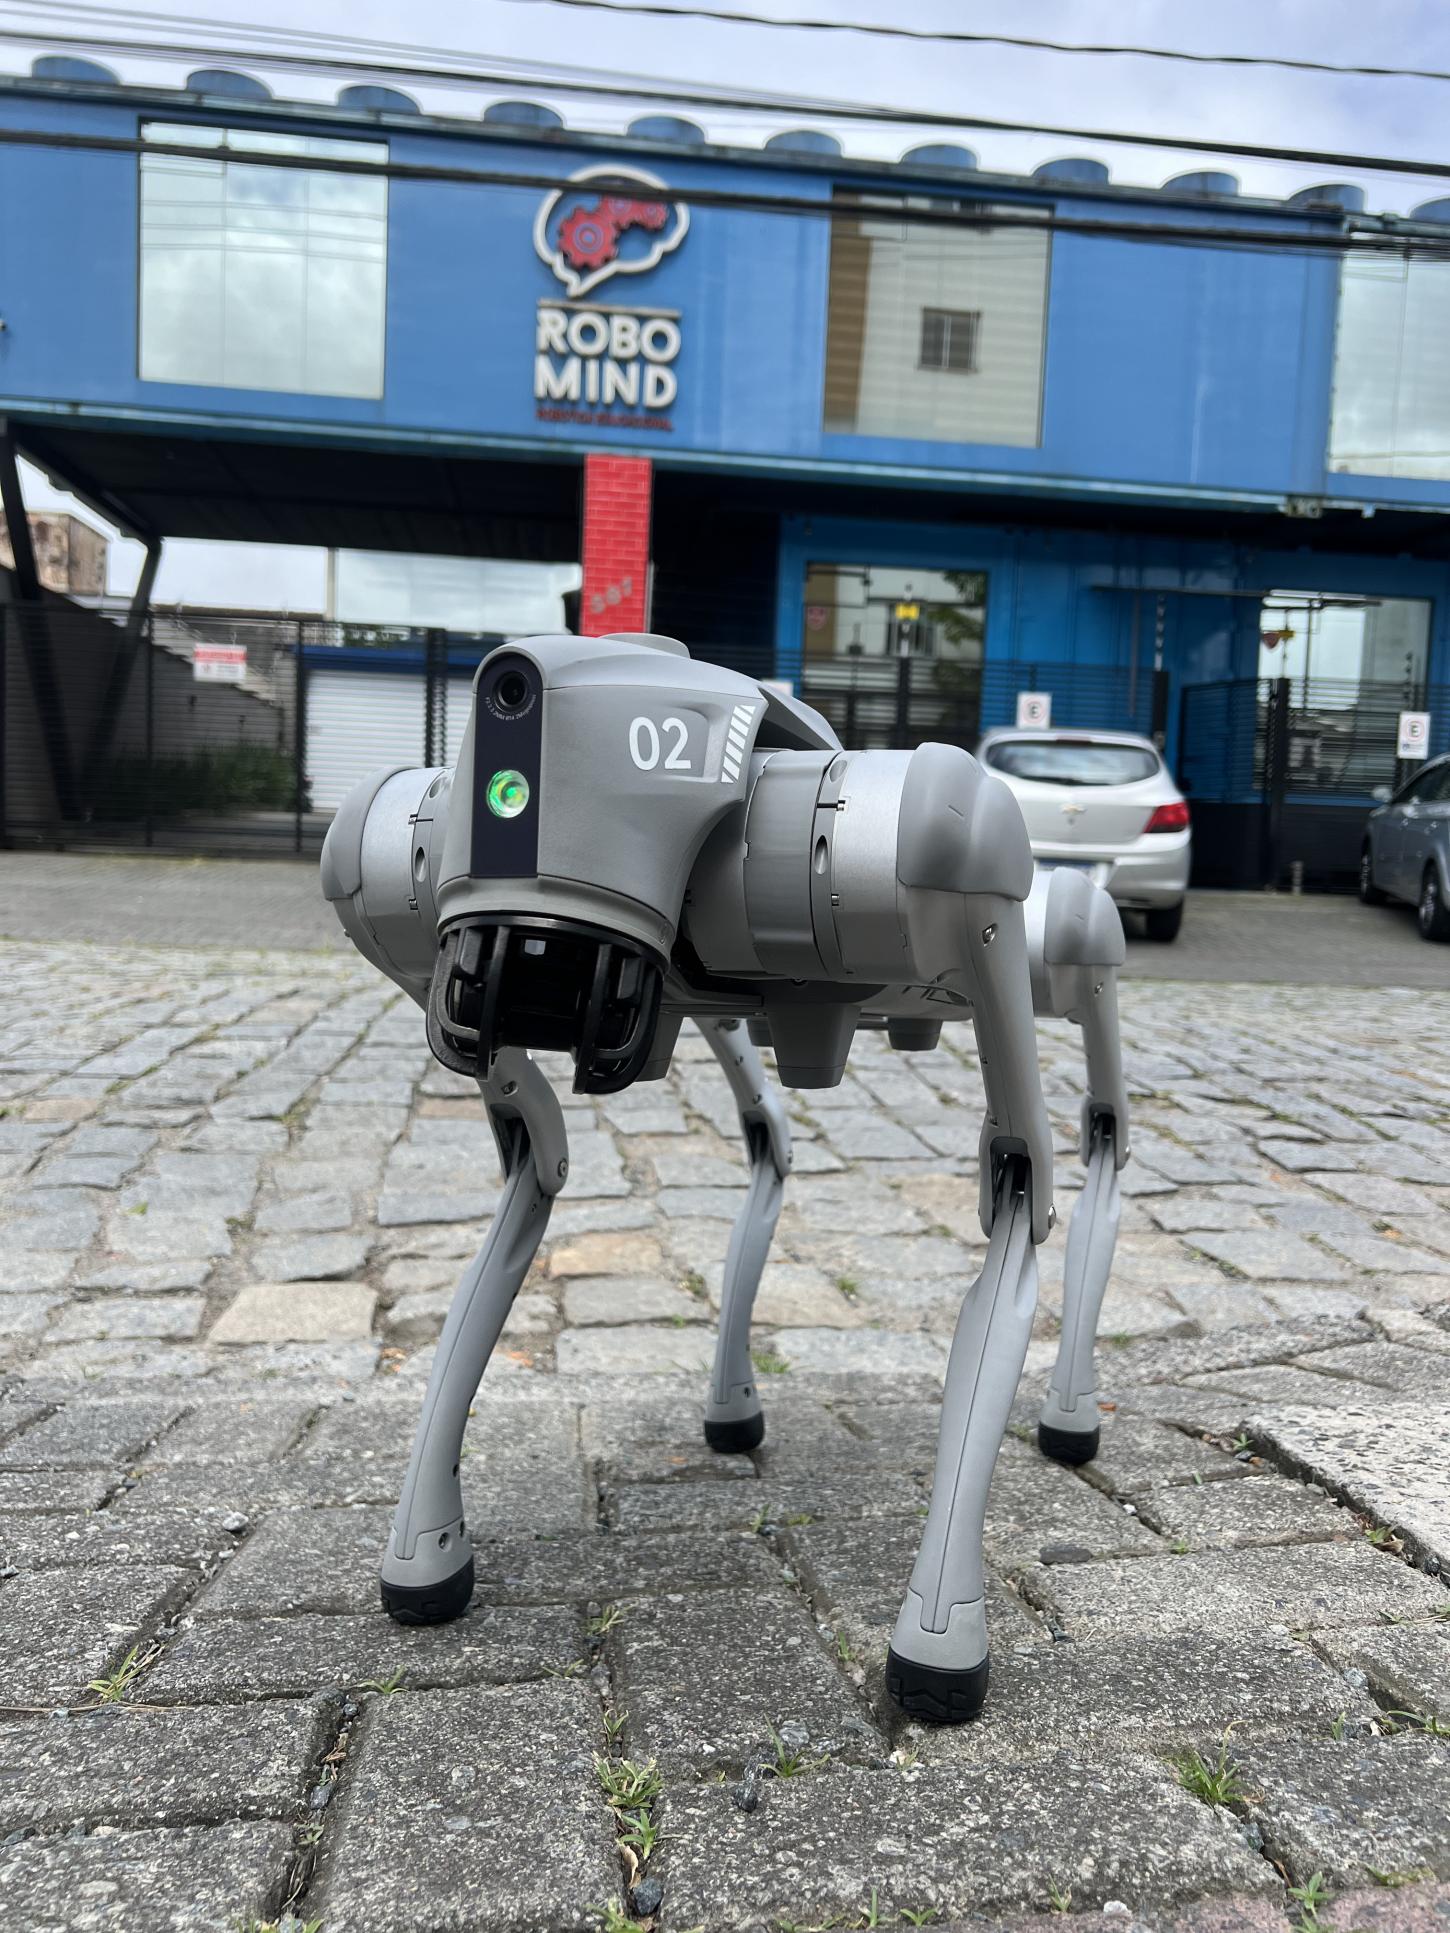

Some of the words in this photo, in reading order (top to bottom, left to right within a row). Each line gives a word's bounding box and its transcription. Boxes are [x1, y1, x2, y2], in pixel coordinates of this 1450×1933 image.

[537, 308, 681, 363] ROBO
[534, 353, 678, 408] MIND
[628, 716, 692, 771] 02
[1411, 724, 1420, 737] E
